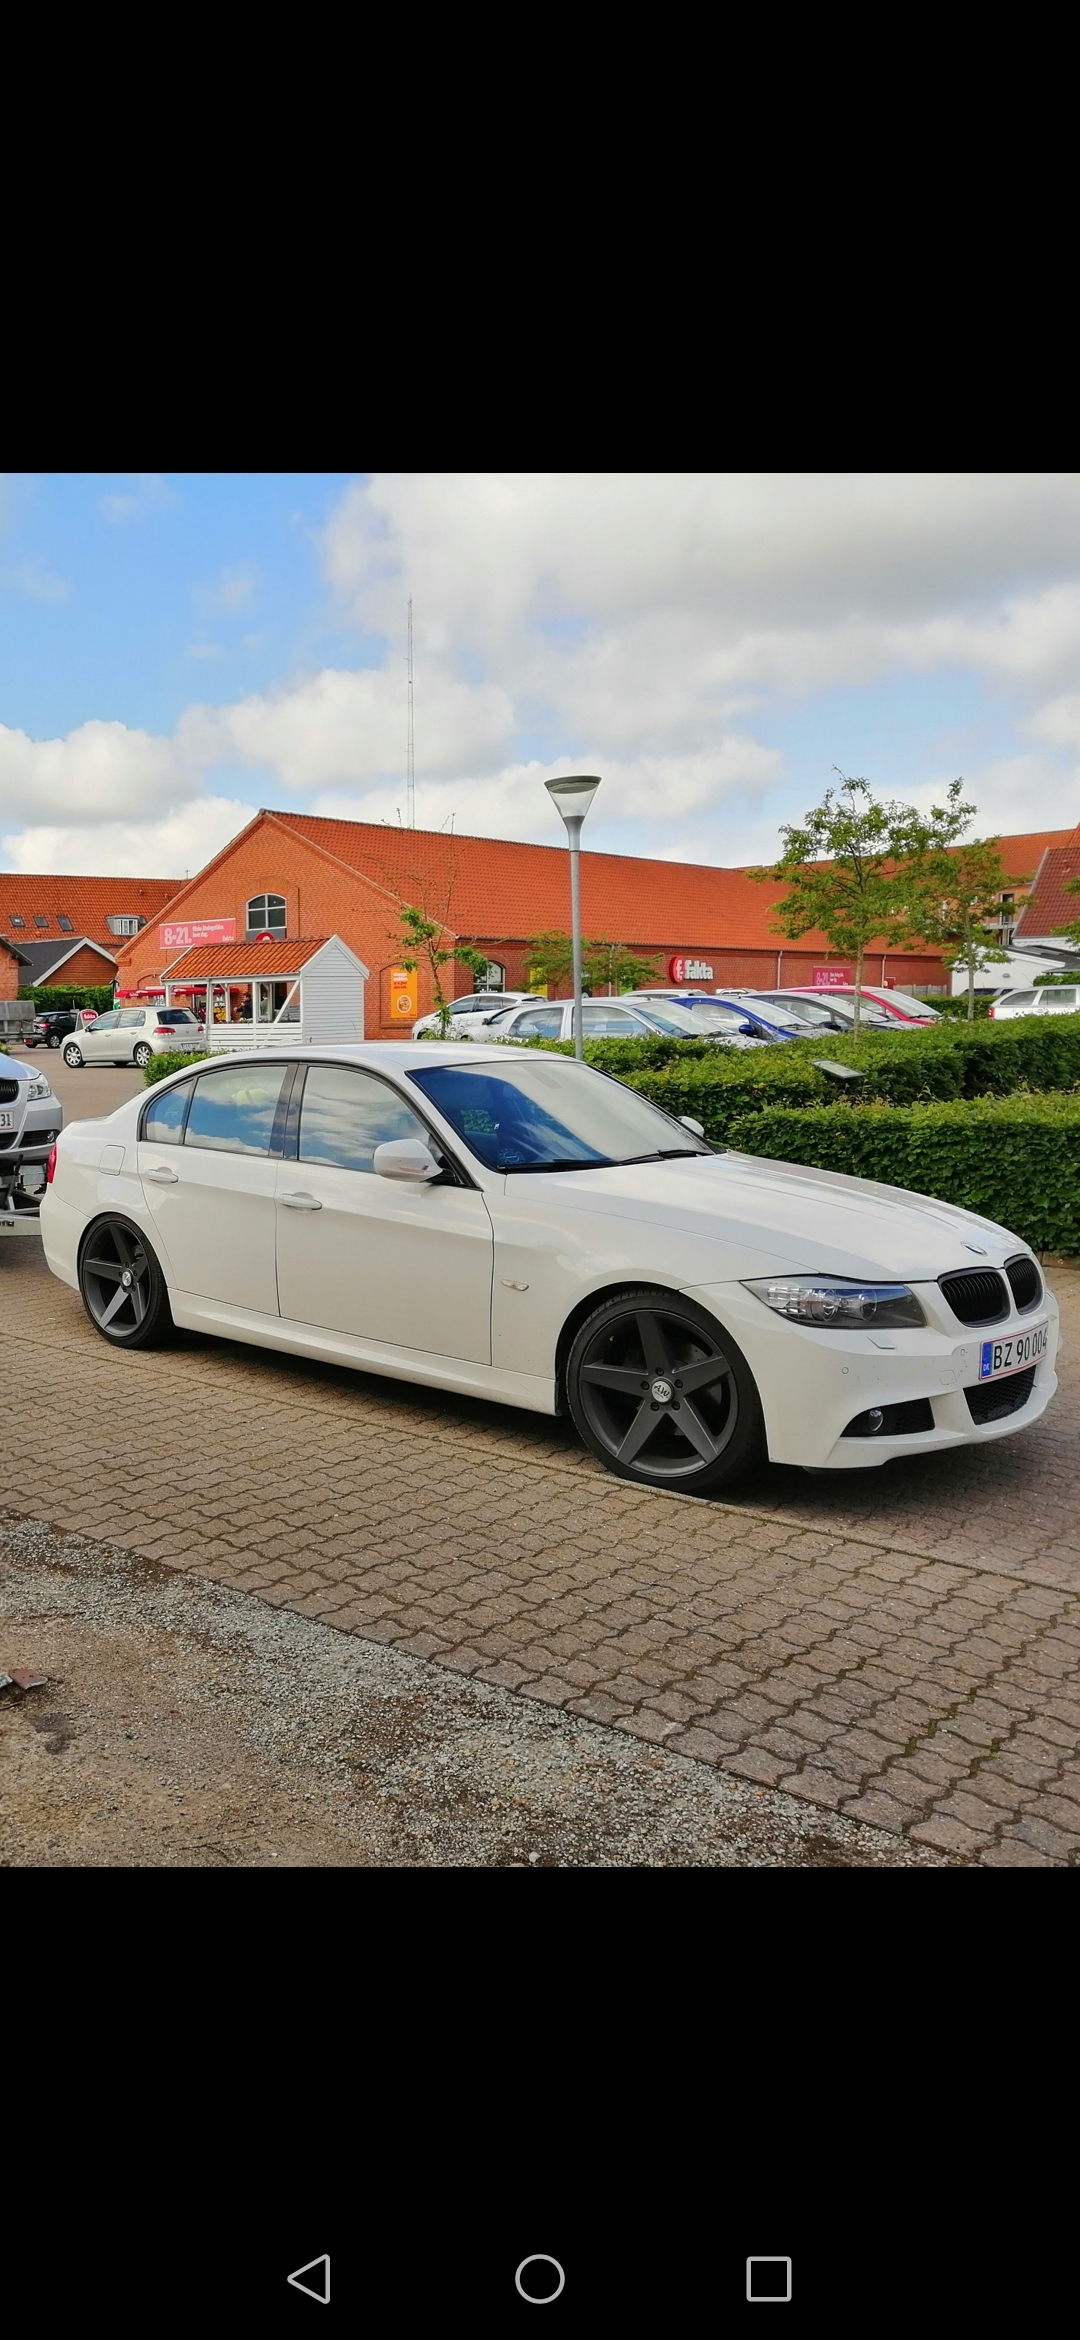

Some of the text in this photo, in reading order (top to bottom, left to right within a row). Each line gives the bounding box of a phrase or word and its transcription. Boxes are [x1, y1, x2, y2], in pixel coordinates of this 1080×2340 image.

[164, 928, 192, 945] 8-21.
[684, 959, 714, 980] fakta
[994, 1326, 1048, 1370] BZ 90 004
